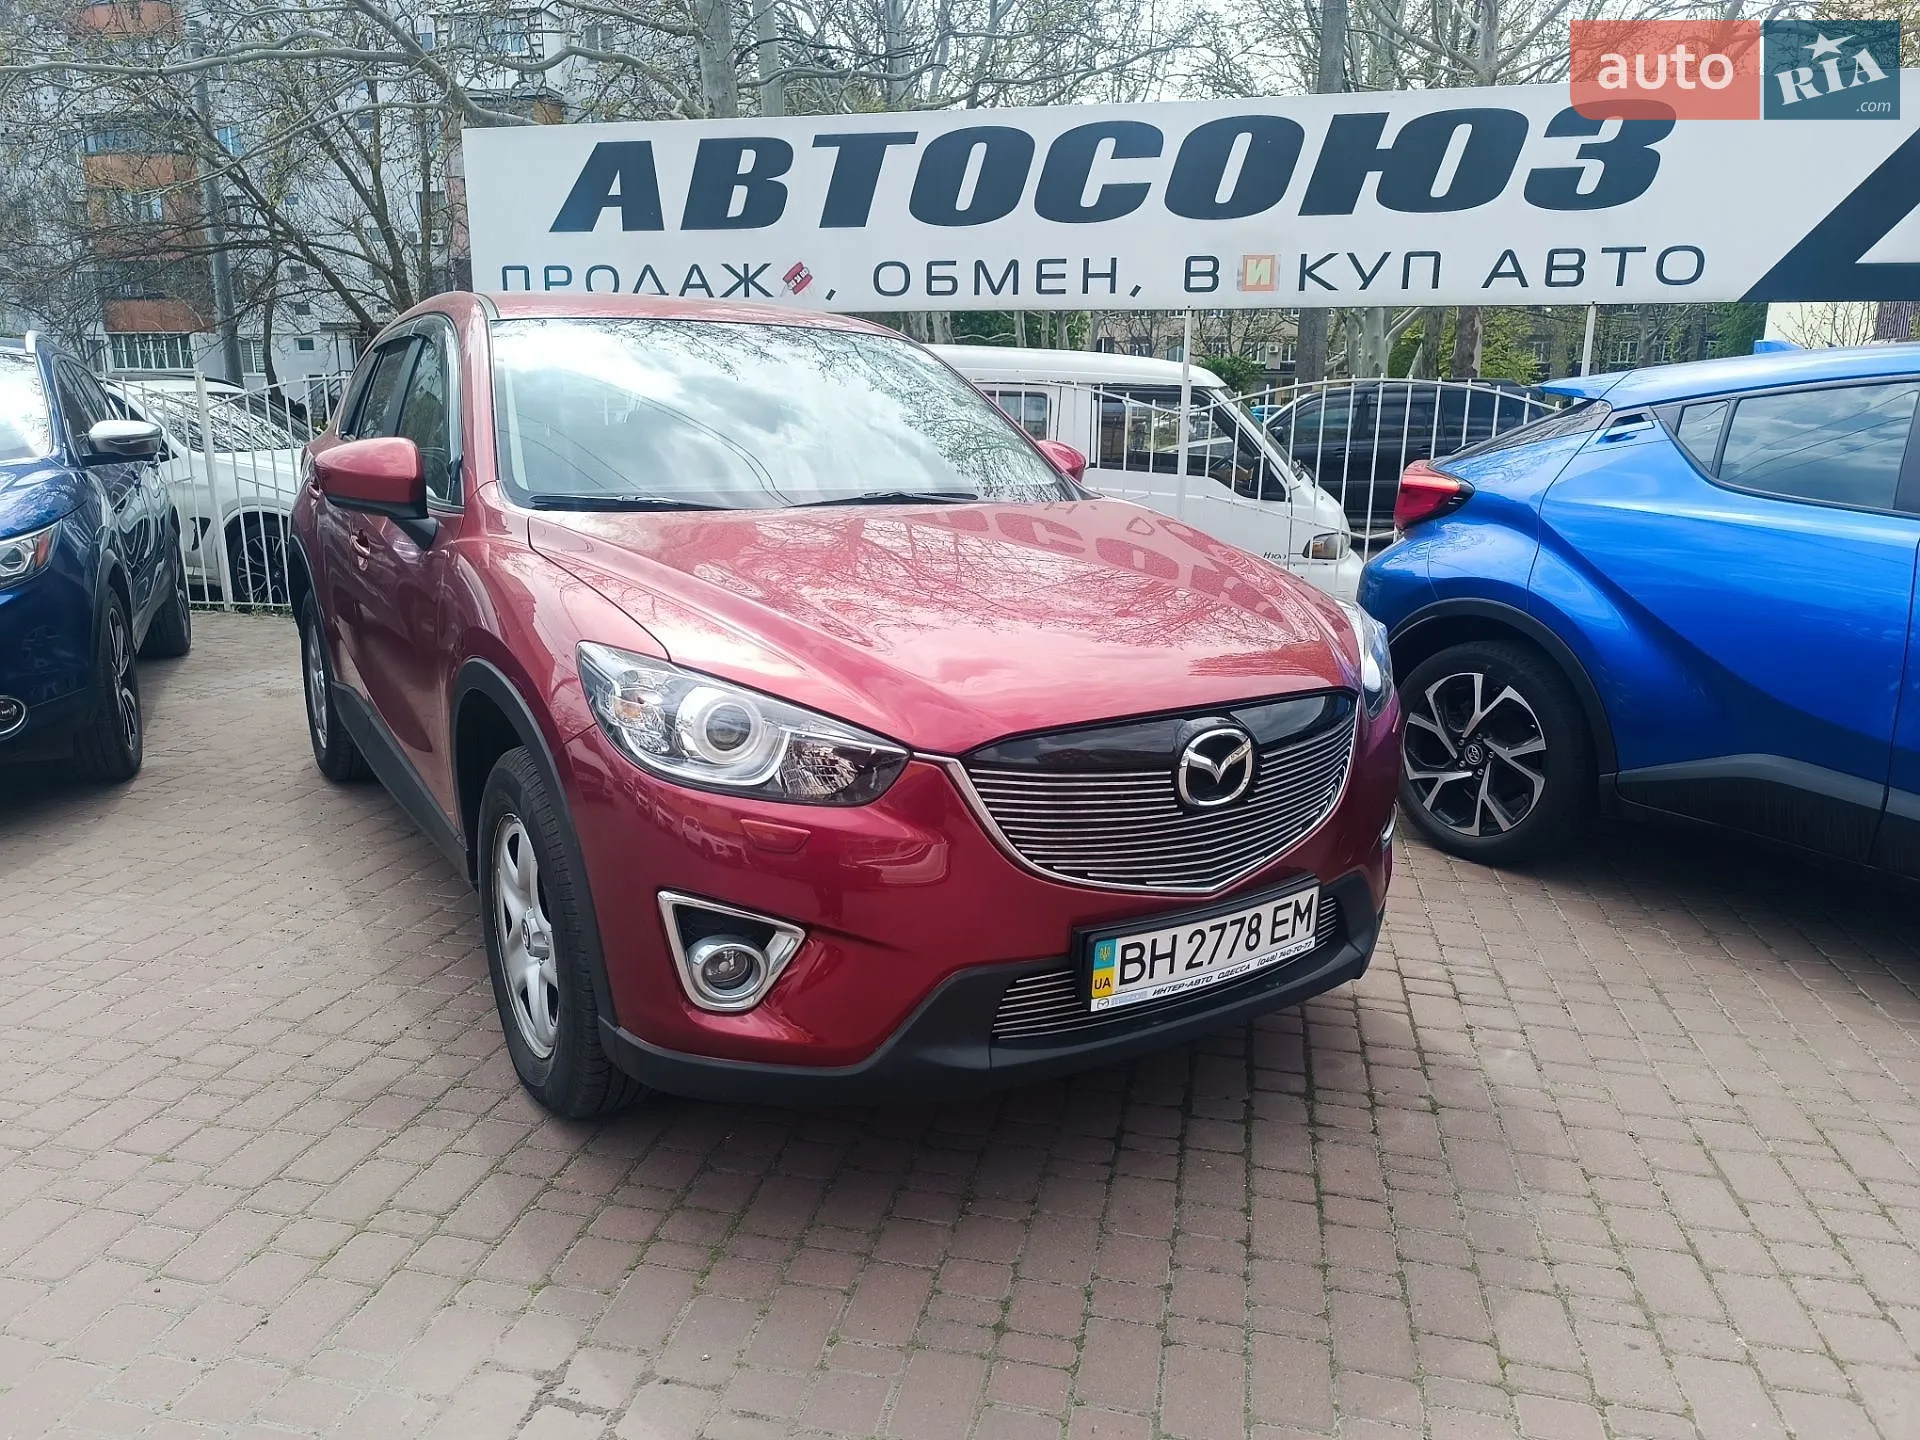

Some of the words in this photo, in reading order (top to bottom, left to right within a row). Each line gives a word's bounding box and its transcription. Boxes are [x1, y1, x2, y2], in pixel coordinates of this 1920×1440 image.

[550, 99, 1677, 232] АВТОСОЮЗ
[1482, 245, 1707, 289] АВТО
[1119, 934, 1178, 986] BH
[1185, 912, 1263, 970] 2778
[1269, 893, 1315, 946] EM
[1094, 977, 1111, 990] UA
[1152, 975, 1213, 997] ИНТЕР-АВТО
